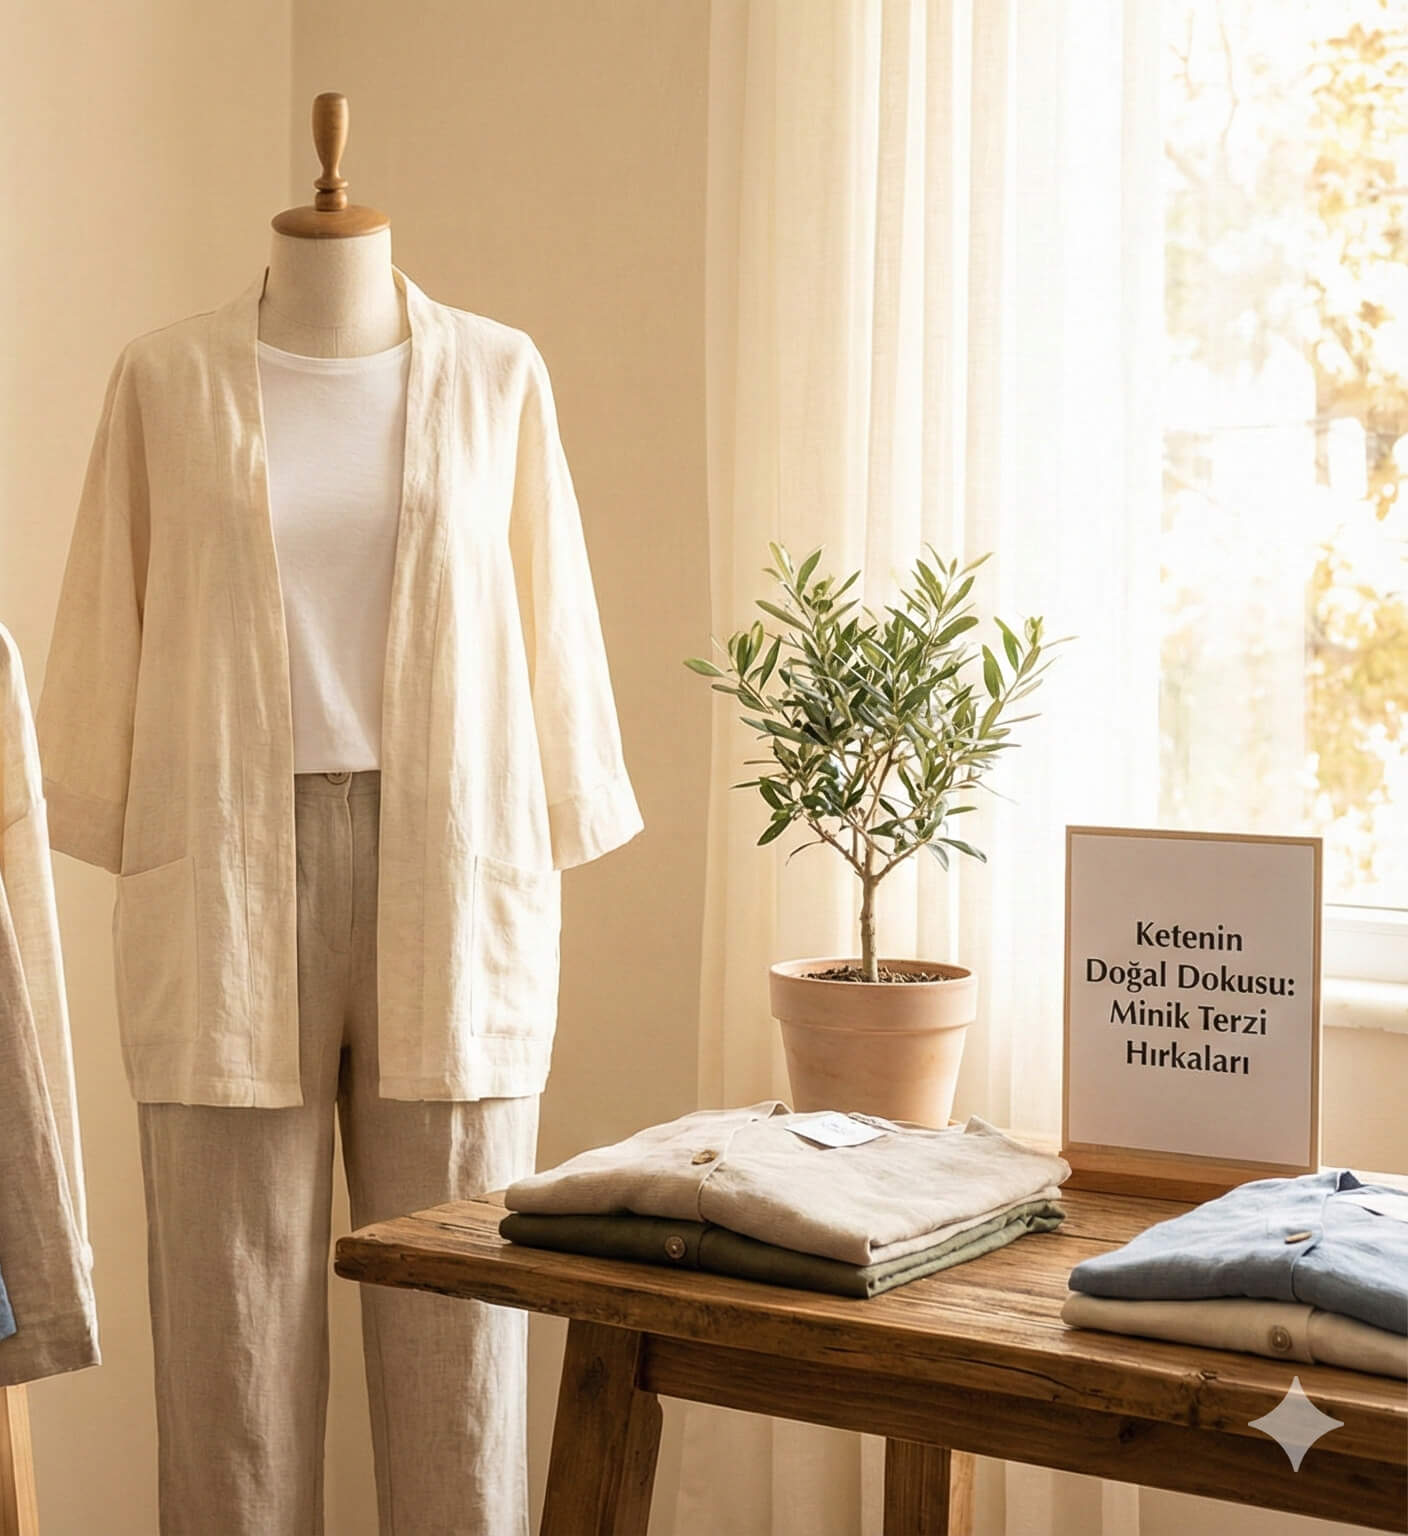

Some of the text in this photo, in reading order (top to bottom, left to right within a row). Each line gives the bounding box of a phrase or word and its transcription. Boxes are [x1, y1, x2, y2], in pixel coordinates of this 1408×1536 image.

[1136, 921, 1243, 952] Ketenin
[1086, 957, 1296, 997] Doğal Dokusu:
[1110, 999, 1268, 1036] Minik Terzi
[1126, 1040, 1250, 1076] Hırkaları
